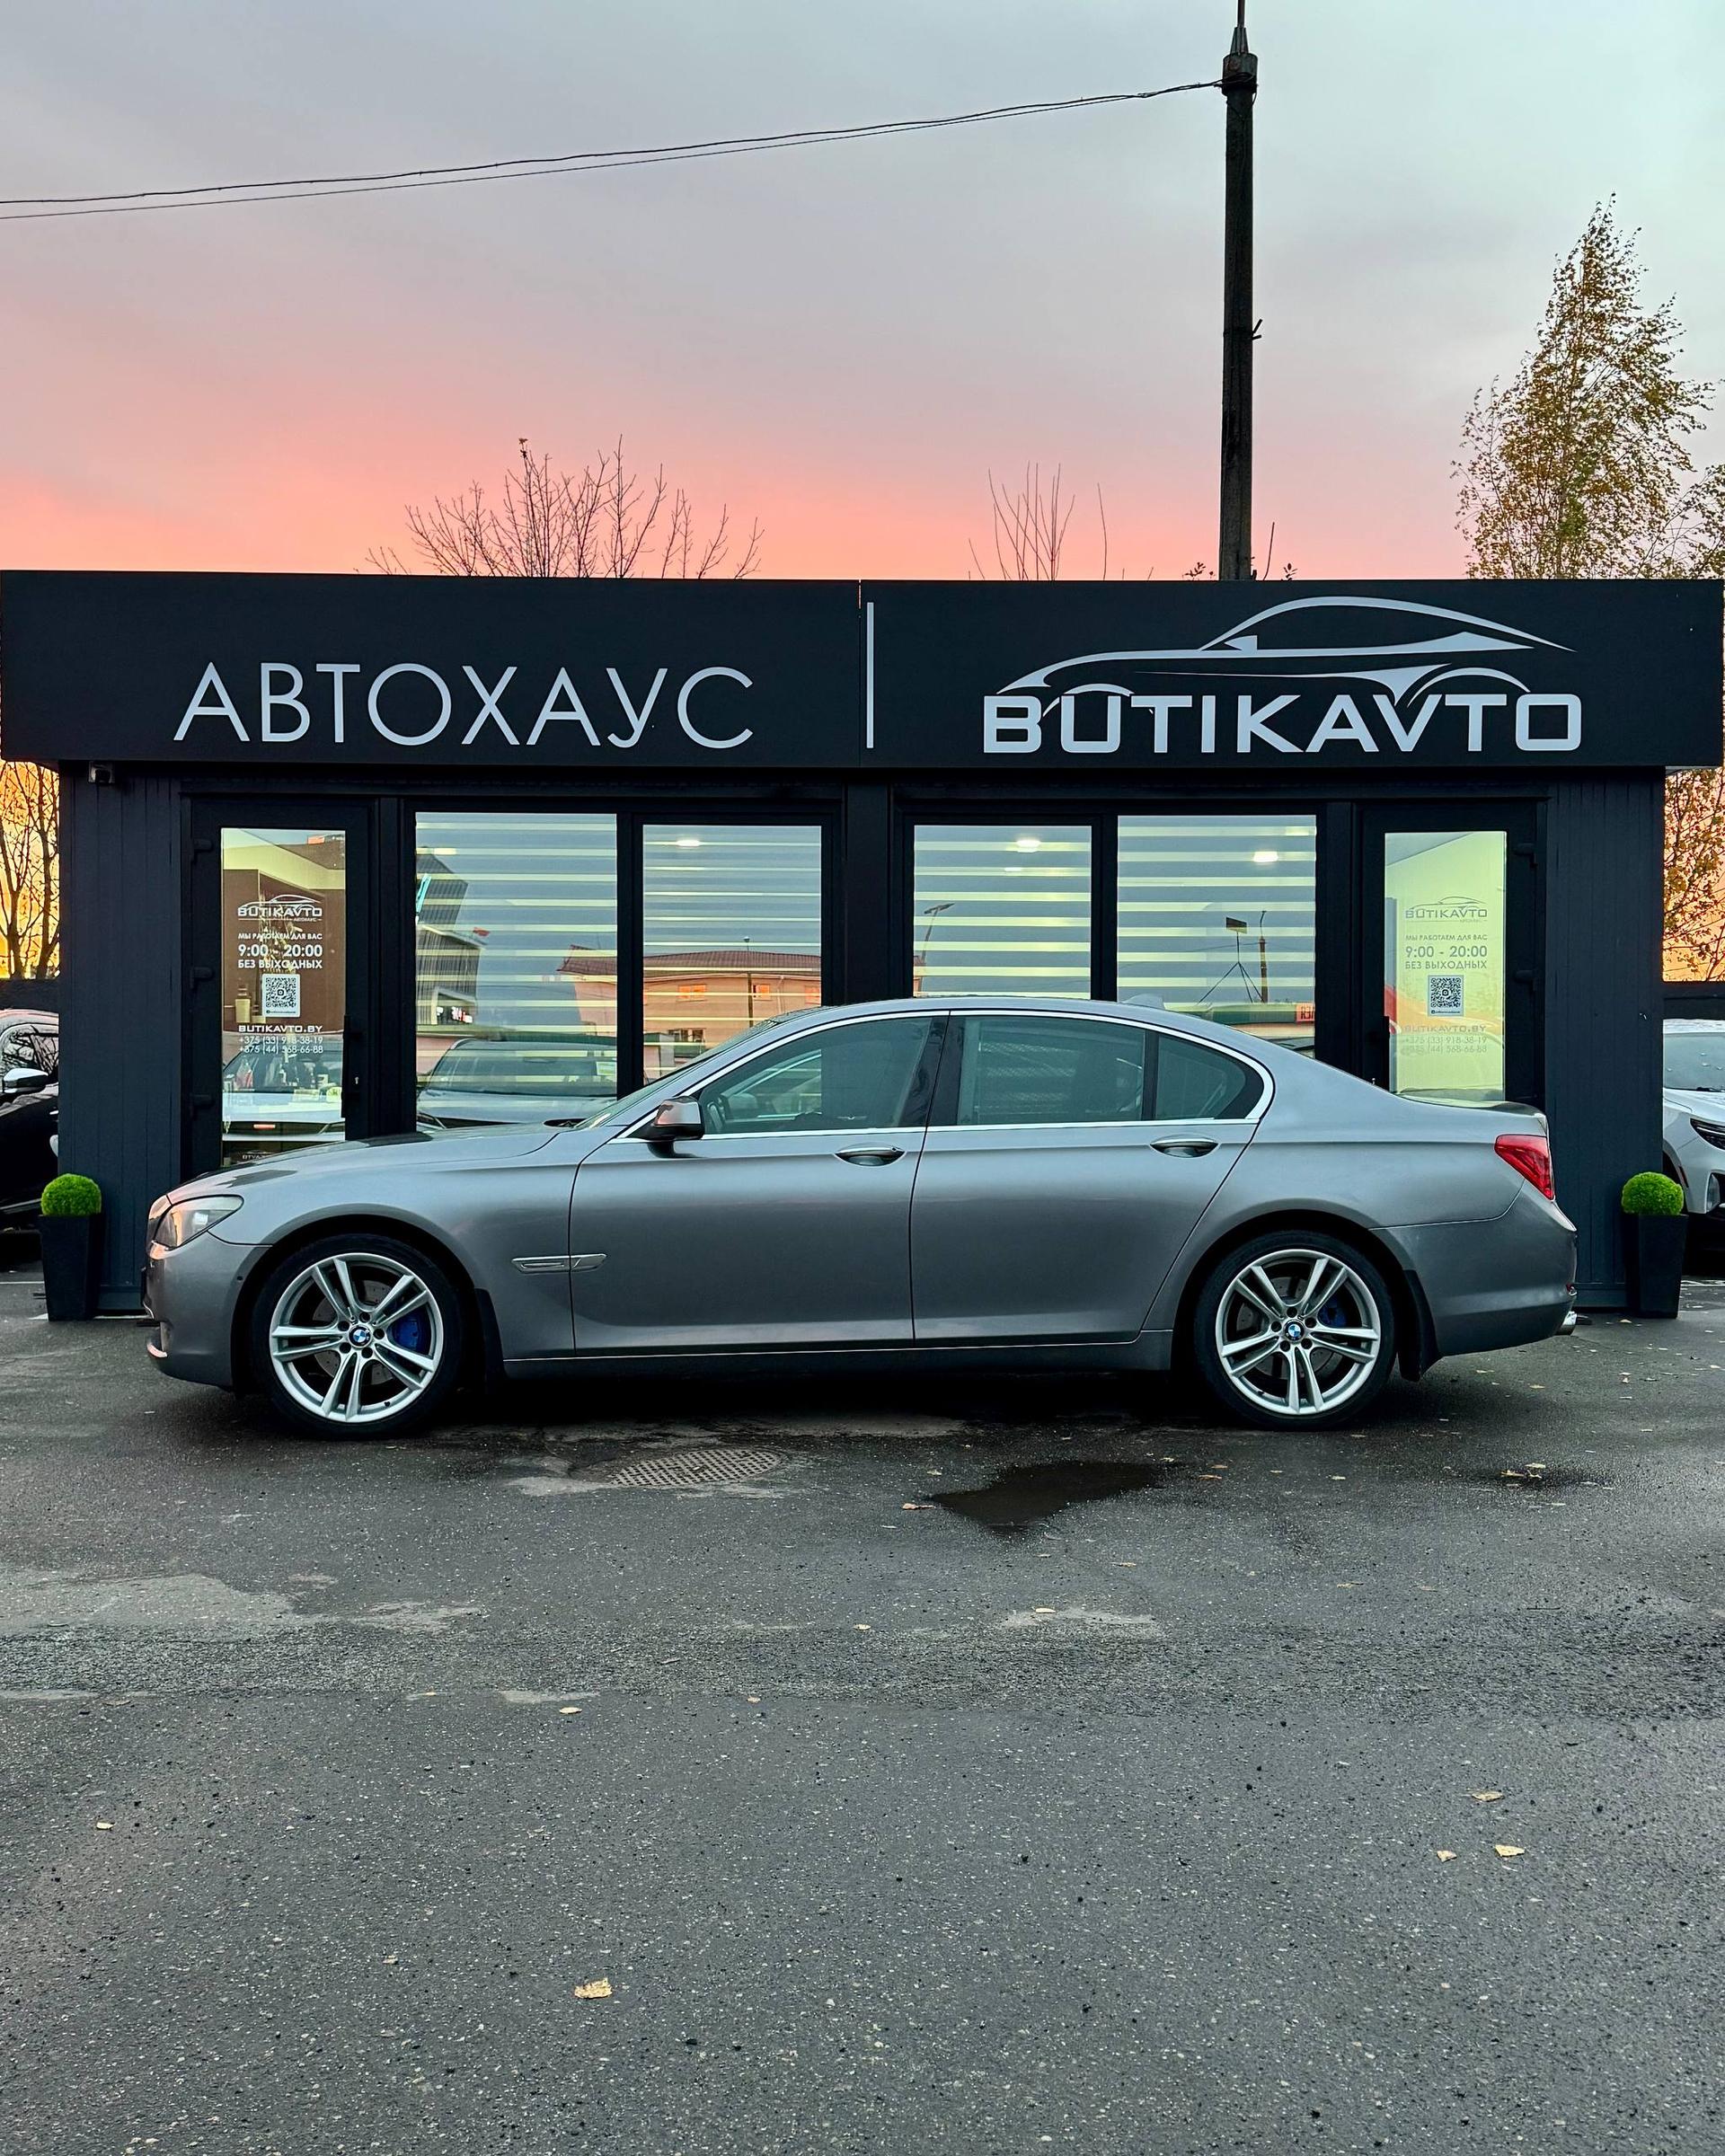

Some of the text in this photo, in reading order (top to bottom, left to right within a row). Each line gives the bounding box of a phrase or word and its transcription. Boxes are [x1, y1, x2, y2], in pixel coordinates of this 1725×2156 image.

[172, 661, 753, 749] АВТОХАУС
[983, 694, 1582, 754] BUTIKAVTO
[237, 907, 323, 917] BUTIKAVTO
[1405, 909, 1488, 918] BUTIKAVTO
[238, 944, 269, 957] 9:00
[283, 944, 323, 957] 20:00
[1405, 946, 1435, 958] 9:00
[1449, 945, 1488, 958] 20:00
[237, 959, 323, 969] БЕЗ ВЫХОДНЫХ
[1405, 960, 1488, 970] БЕЗ ВЫХОДНЫХ
[239, 1036, 261, 1044] +375
